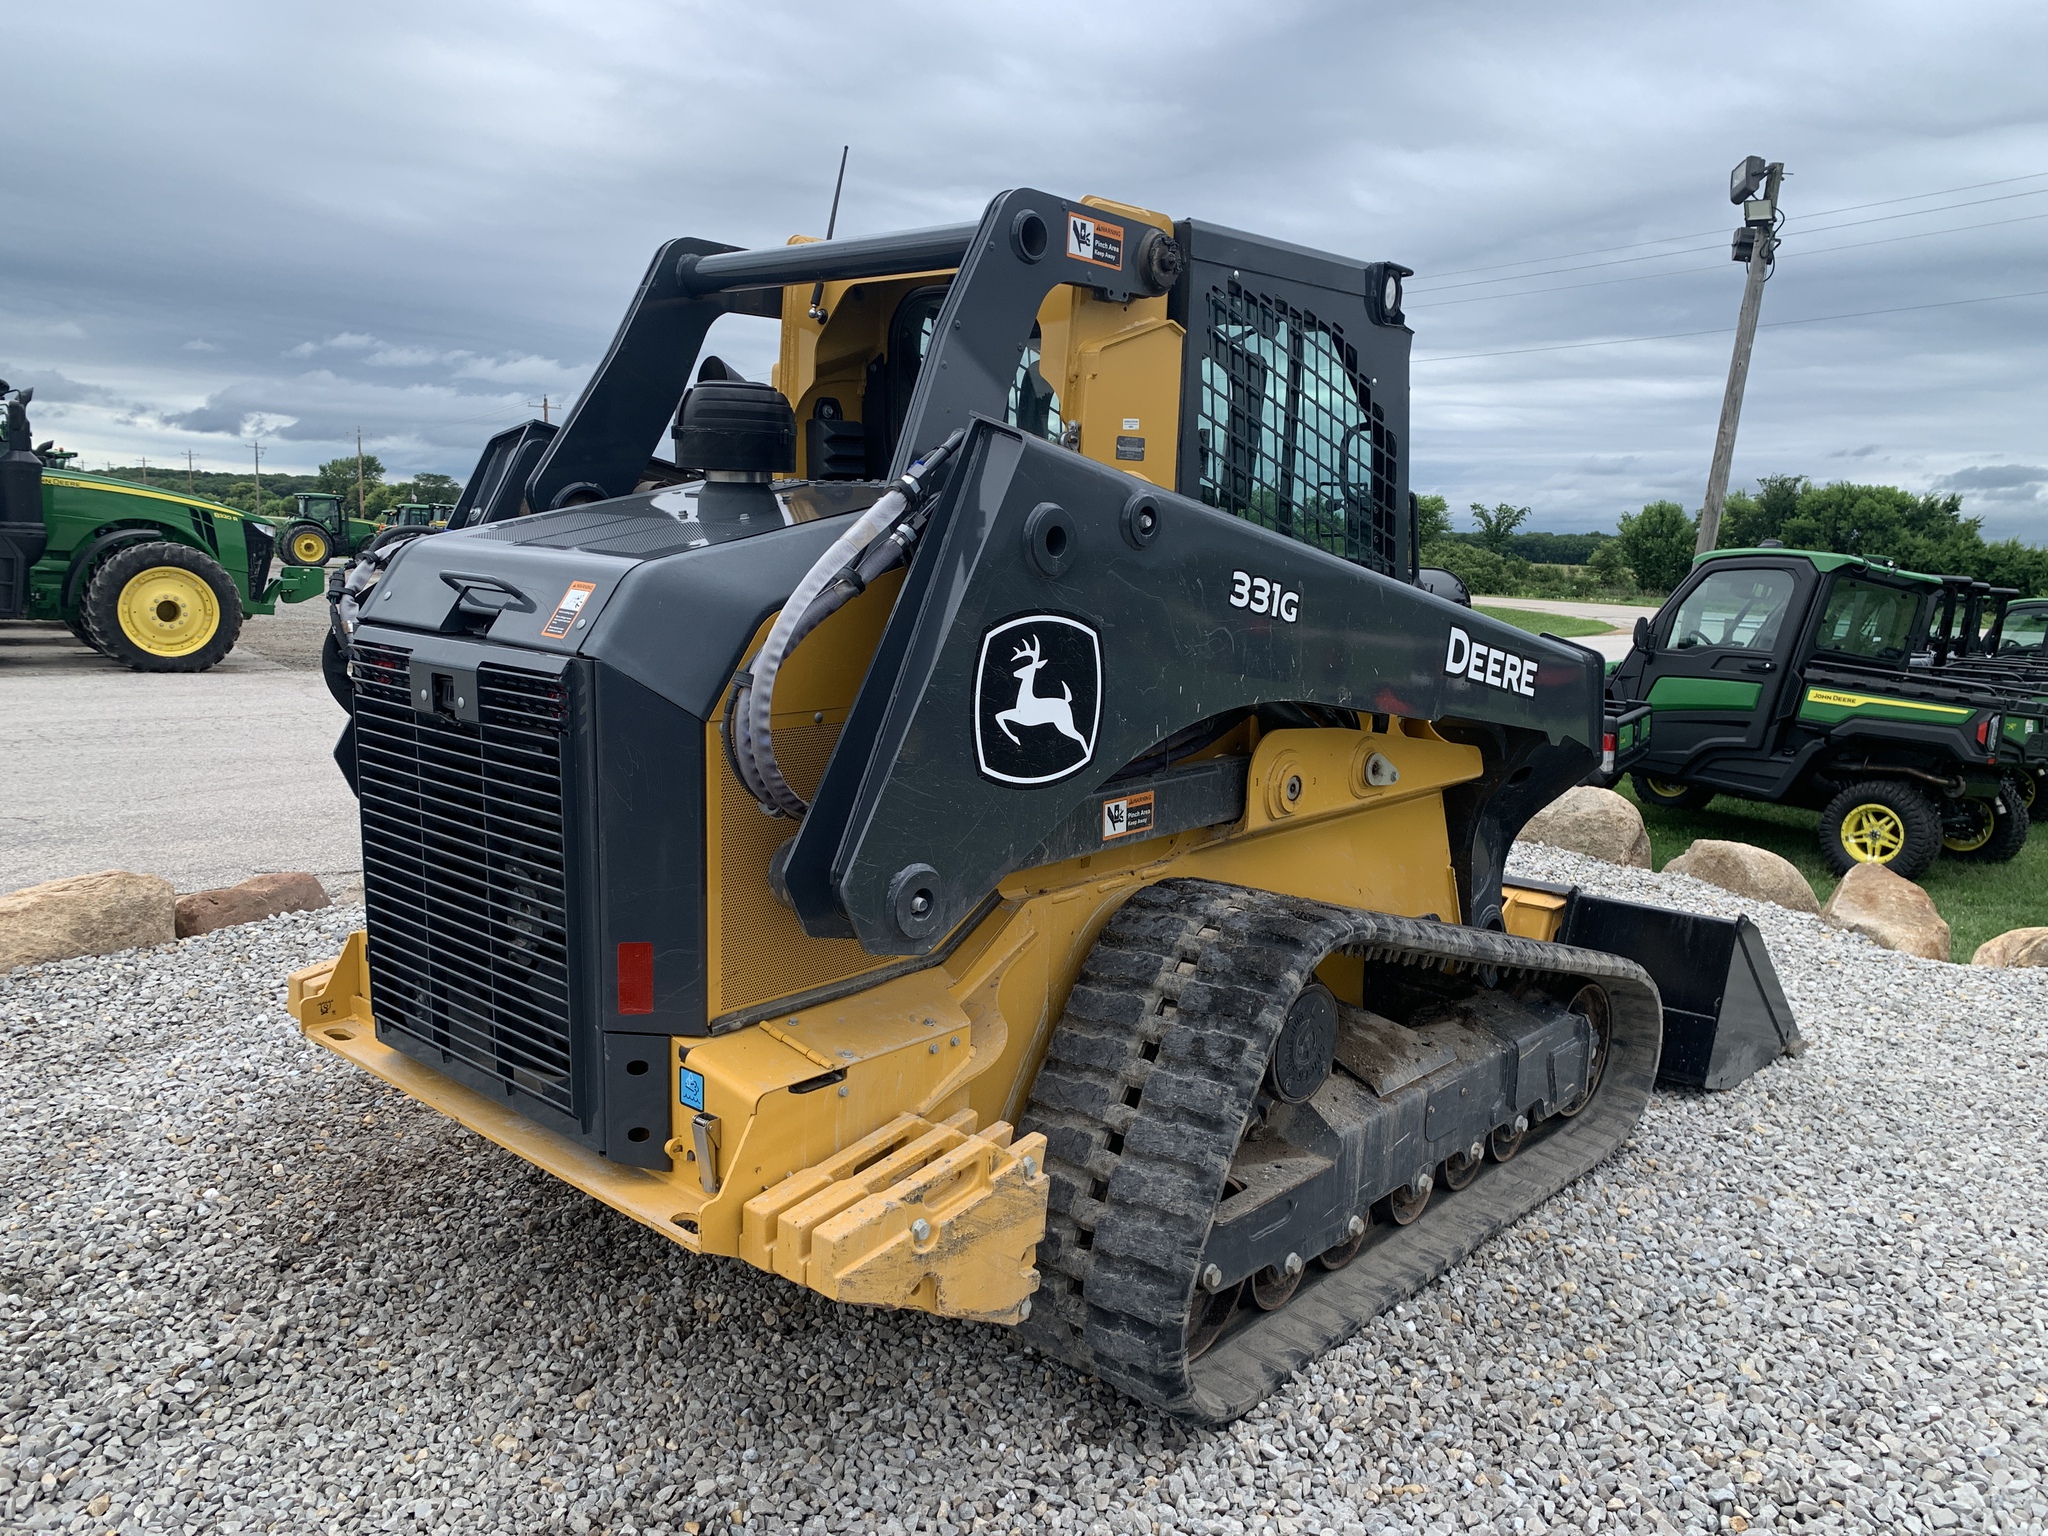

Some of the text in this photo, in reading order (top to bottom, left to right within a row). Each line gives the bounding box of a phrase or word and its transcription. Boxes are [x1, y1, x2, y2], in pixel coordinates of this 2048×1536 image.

[1099, 225, 1121, 238] WARNING
[1094, 239, 1120, 253] Pinch Area
[1094, 249, 1116, 261] Keep Away
[53, 478, 80, 487] DEERE
[1229, 571, 1299, 622] 331G
[1445, 626, 1538, 697] DEERE
[1813, 693, 1857, 704] JOHN DEERE
[1127, 811, 1140, 819] Pinch
